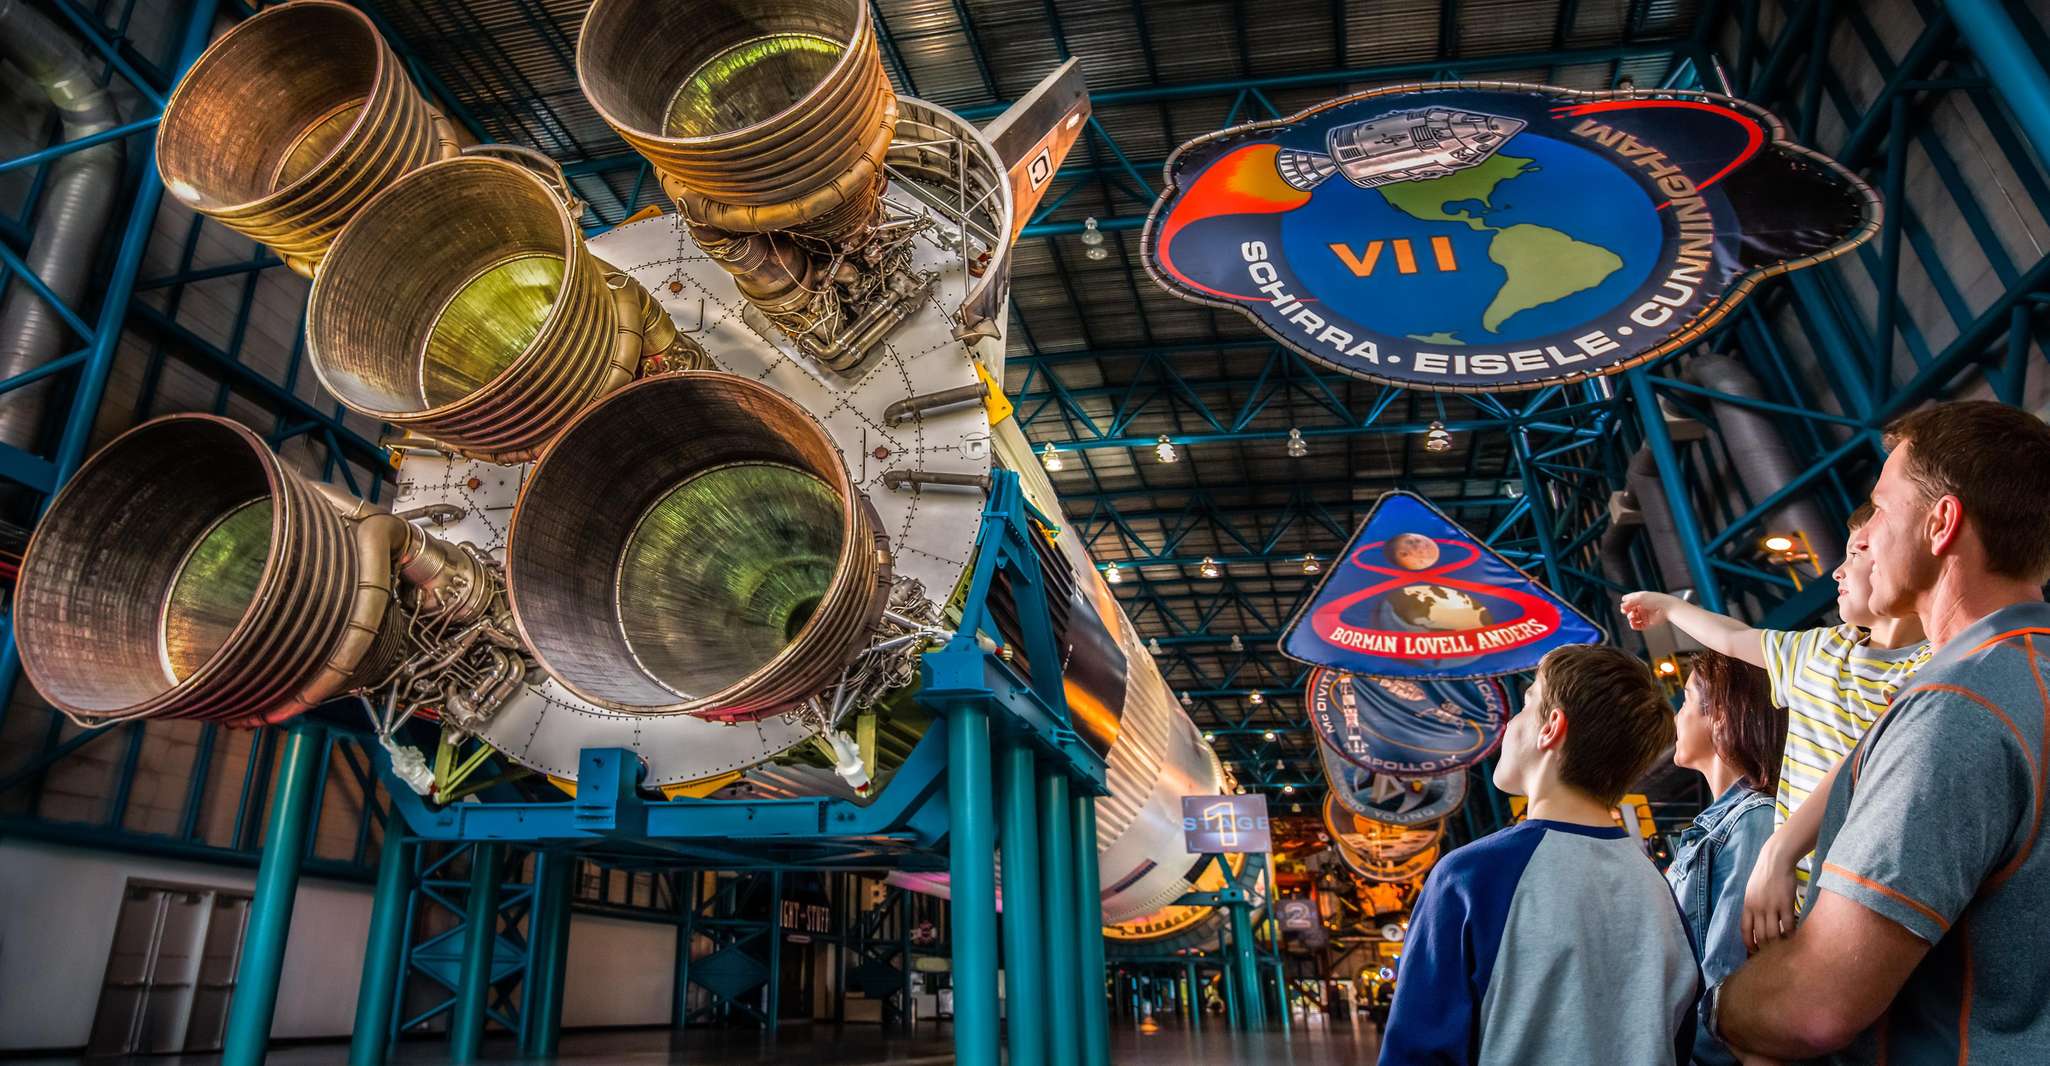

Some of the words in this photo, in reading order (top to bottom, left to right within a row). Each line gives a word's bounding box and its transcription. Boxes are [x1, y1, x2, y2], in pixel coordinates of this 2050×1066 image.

[1241, 240, 1380, 365] SCHIRRA
[1413, 330, 1621, 375] EISELE
[1570, 118, 1714, 327] CUNNINGHAM
[1329, 235, 1457, 277] VII
[1329, 626, 1397, 654] BORMAN
[1404, 636, 1475, 655] LOVELL
[1478, 618, 1549, 650] ANDERS
[1474, 679, 1498, 731] ICKART
[1359, 754, 1436, 771] APOLLO
[1440, 755, 1461, 767] IX
[1184, 816, 1268, 831] STAGE
[1203, 802, 1237, 846] 1
[1374, 808, 1435, 822] YOUNG
[1285, 902, 1312, 928] 2
